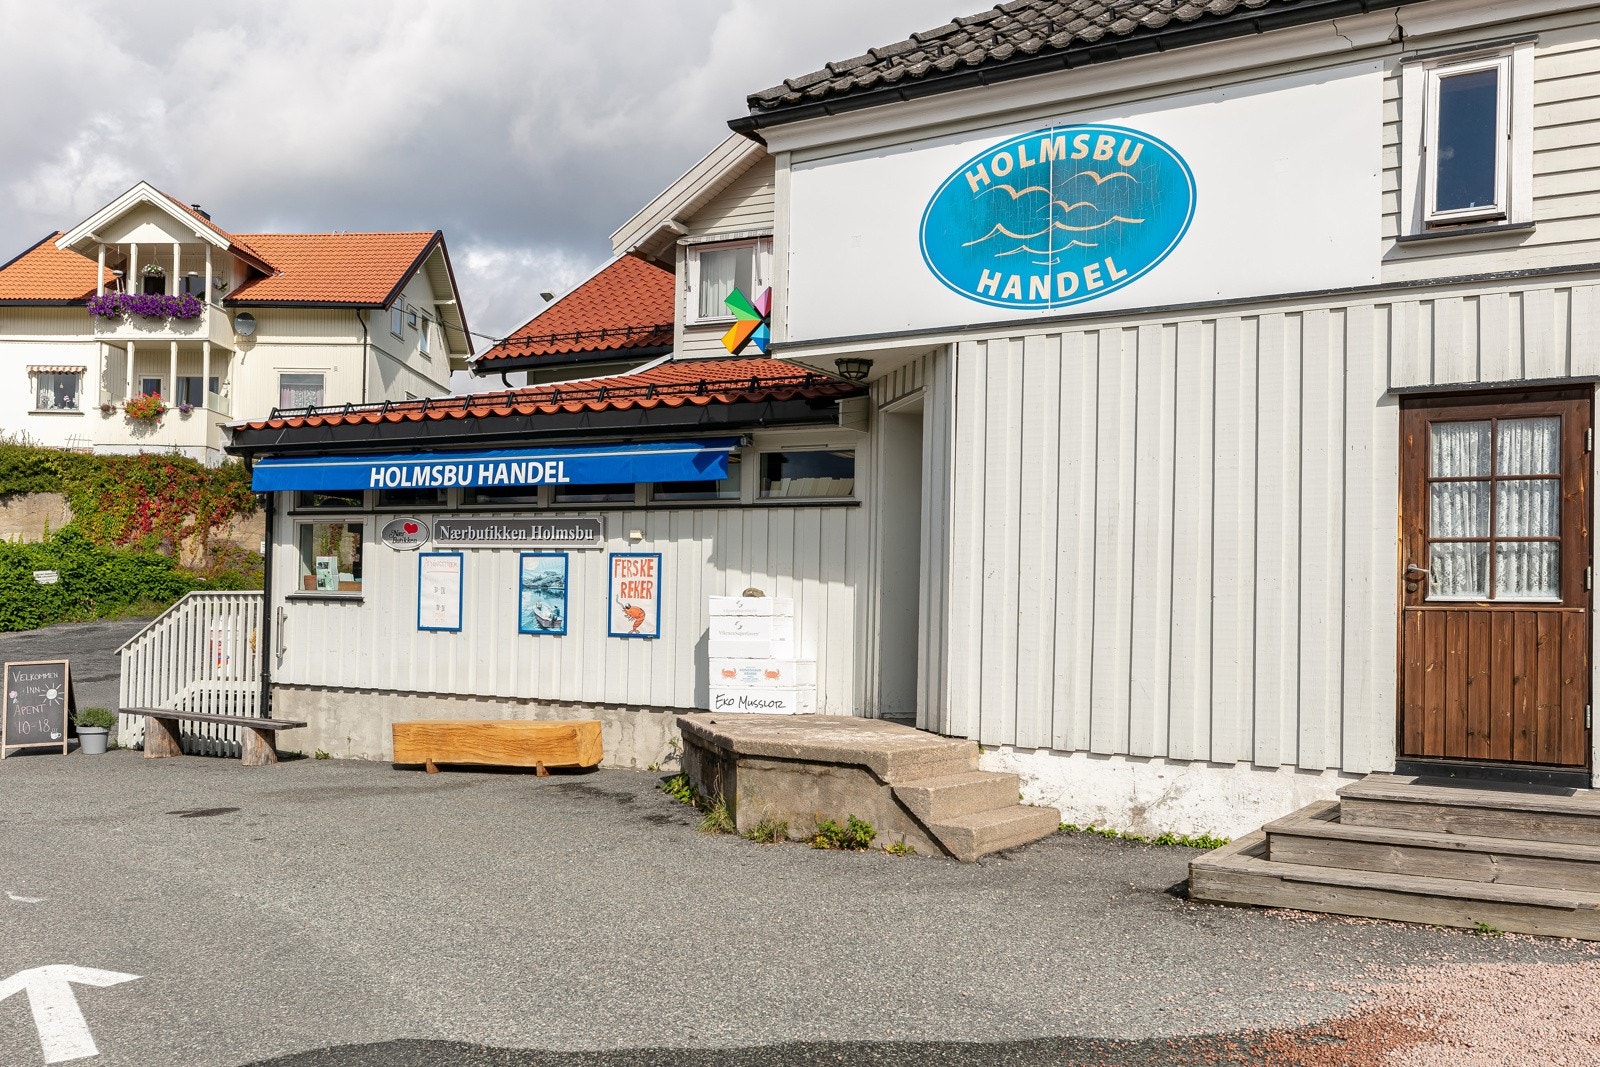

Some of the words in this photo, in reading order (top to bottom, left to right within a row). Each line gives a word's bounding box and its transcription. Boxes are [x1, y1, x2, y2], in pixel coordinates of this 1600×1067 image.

[964, 133, 1144, 193] HOLMSBU
[976, 256, 1128, 301] HANDEL
[370, 464, 473, 488] HOLMSBU
[478, 461, 570, 484] HANDEL
[440, 525, 527, 540] Nærbutikken
[531, 525, 594, 540] Holmsbu
[614, 558, 654, 578] FERSKE
[620, 580, 653, 599] REKER
[12, 671, 58, 682] VELKOMMEN
[18, 719, 50, 734] 10-18
